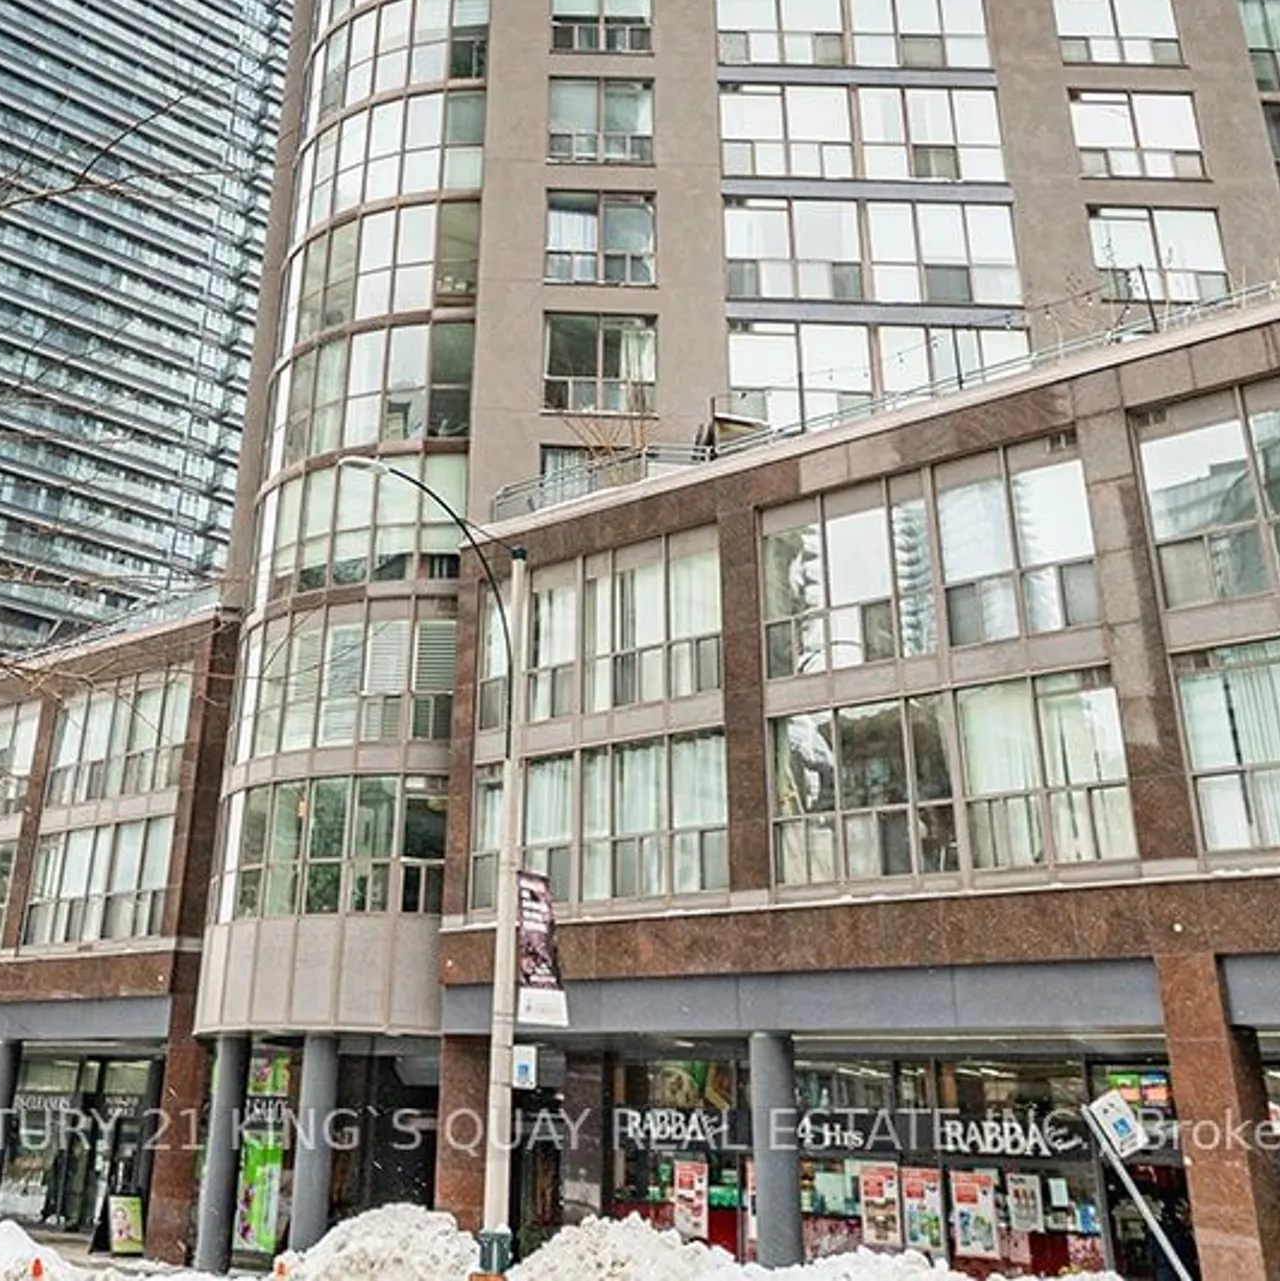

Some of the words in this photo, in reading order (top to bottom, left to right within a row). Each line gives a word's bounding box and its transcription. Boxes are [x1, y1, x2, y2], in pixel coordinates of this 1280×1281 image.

[627, 1111, 705, 1141] RABBA
[822, 1122, 865, 1147] Hrs
[945, 1119, 1052, 1157] RABBA
